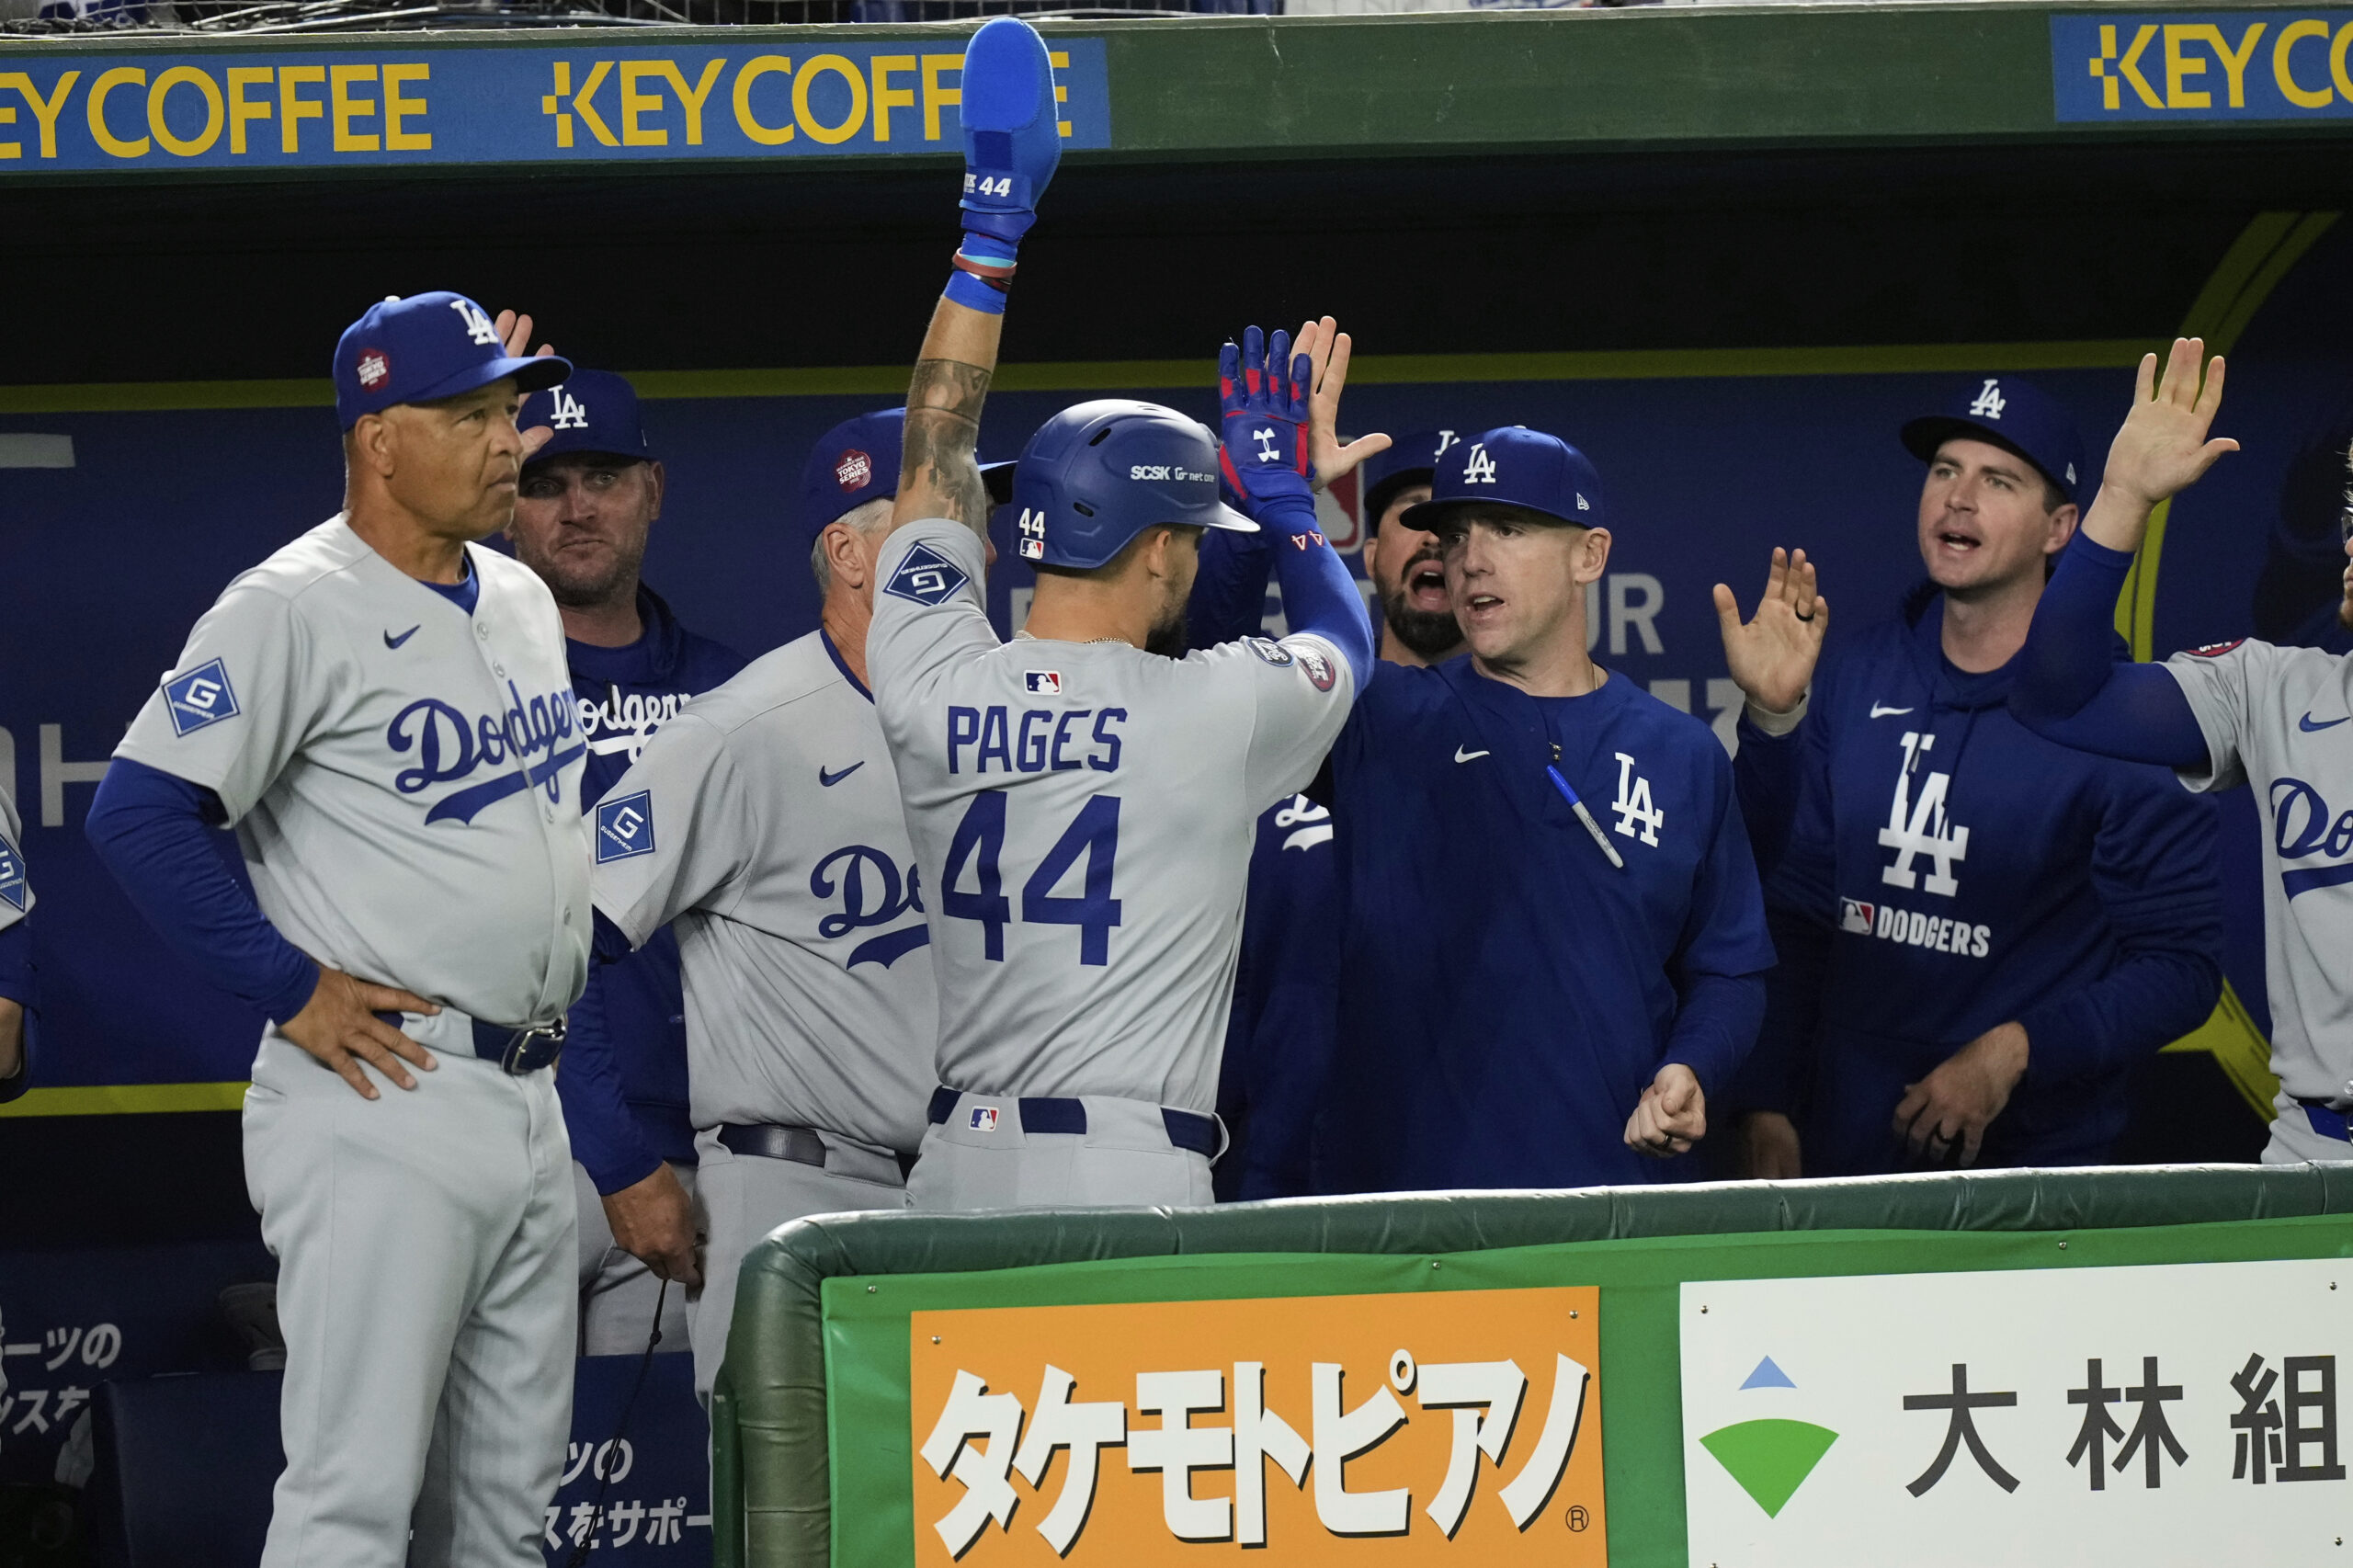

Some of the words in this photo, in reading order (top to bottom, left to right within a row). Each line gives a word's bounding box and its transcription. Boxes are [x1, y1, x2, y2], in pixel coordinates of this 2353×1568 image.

[978, 176, 1012, 198] 44
[449, 299, 499, 346] LA
[549, 385, 588, 429] LA
[1970, 379, 2006, 419] LA
[837, 460, 866, 477] TOKYO
[839, 466, 869, 484] SERIES
[1130, 465, 1171, 481] SCSK
[1463, 443, 1496, 484] LA
[1019, 507, 1046, 540] 44
[947, 705, 1128, 775] PAGES
[1611, 751, 1664, 848] LA
[1877, 731, 1970, 898] LA
[940, 789, 1122, 966] 44
[1876, 904, 1991, 959] DODGERS
[1904, 1352, 2347, 1499] 大林組
[920, 1348, 1591, 1562] タケモトピアノ
